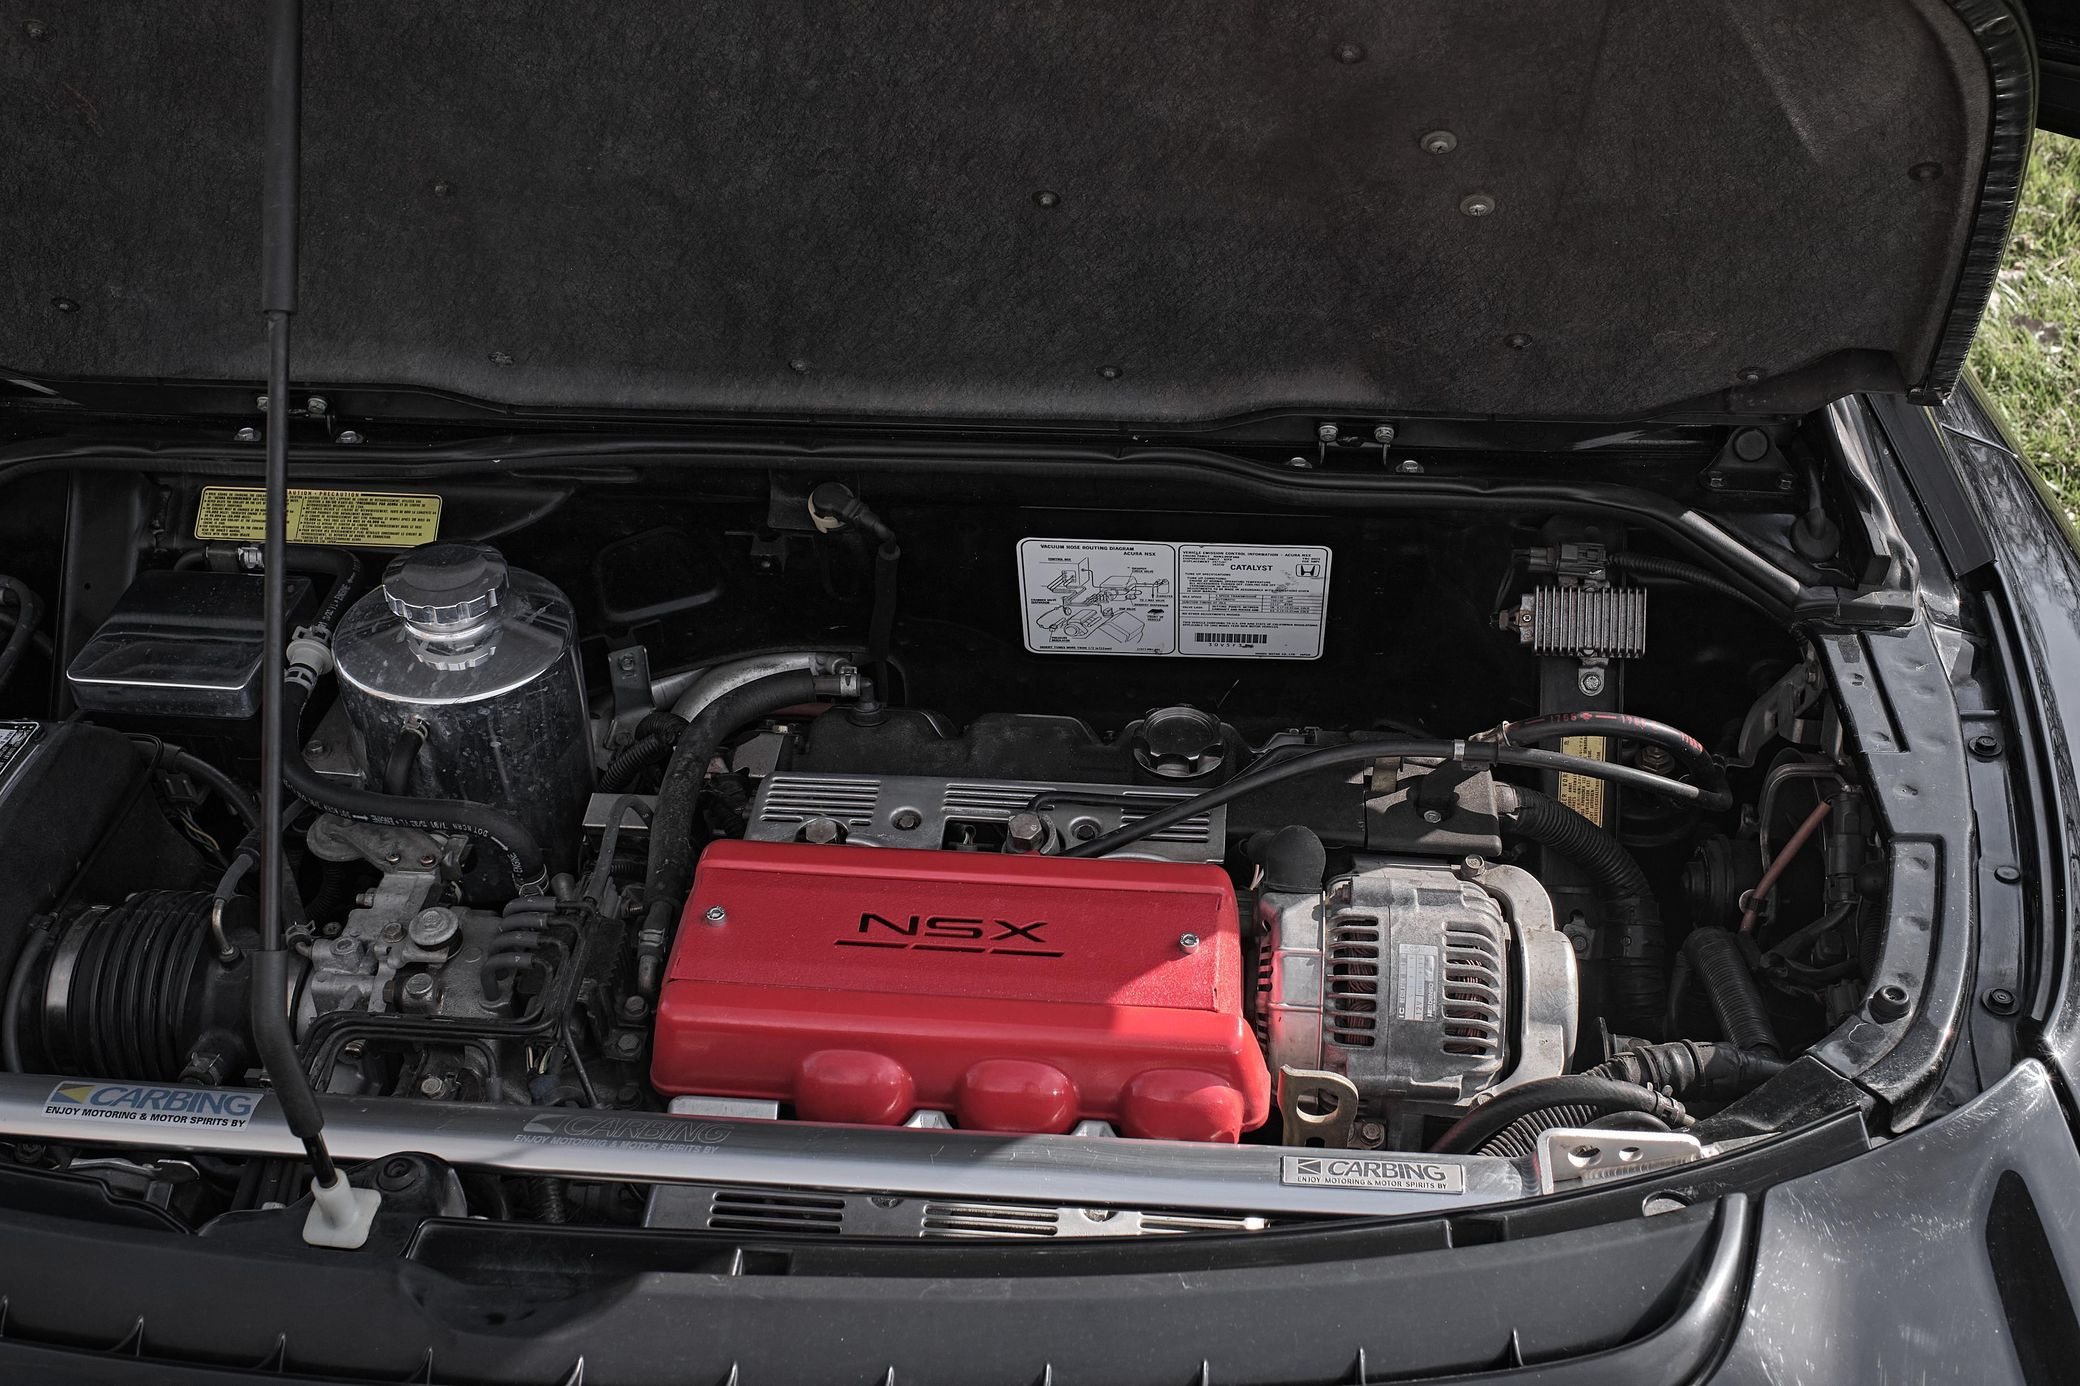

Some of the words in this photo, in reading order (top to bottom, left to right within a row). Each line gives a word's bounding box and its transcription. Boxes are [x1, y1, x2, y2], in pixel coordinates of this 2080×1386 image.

[474, 827, 489, 837] DOT
[507, 852, 523, 873] ENGINE
[857, 912, 1048, 943] NSX
[1399, 1007, 1404, 1018] IC
[90, 1086, 252, 1117] CARBING
[45, 1106, 80, 1116] ENJOY
[82, 1108, 137, 1120] MOTORING
[150, 1114, 188, 1124] MOTOR
[190, 1116, 228, 1126] SPIRITS
[230, 1119, 246, 1128] BY
[562, 1115, 734, 1143] CARBING
[513, 1134, 550, 1144] ENJOY
[550, 1136, 608, 1147] MOTORING
[619, 1140, 659, 1151] MOTOR
[661, 1143, 701, 1153] SPIRITS
[1328, 1160, 1446, 1182] CARBING
